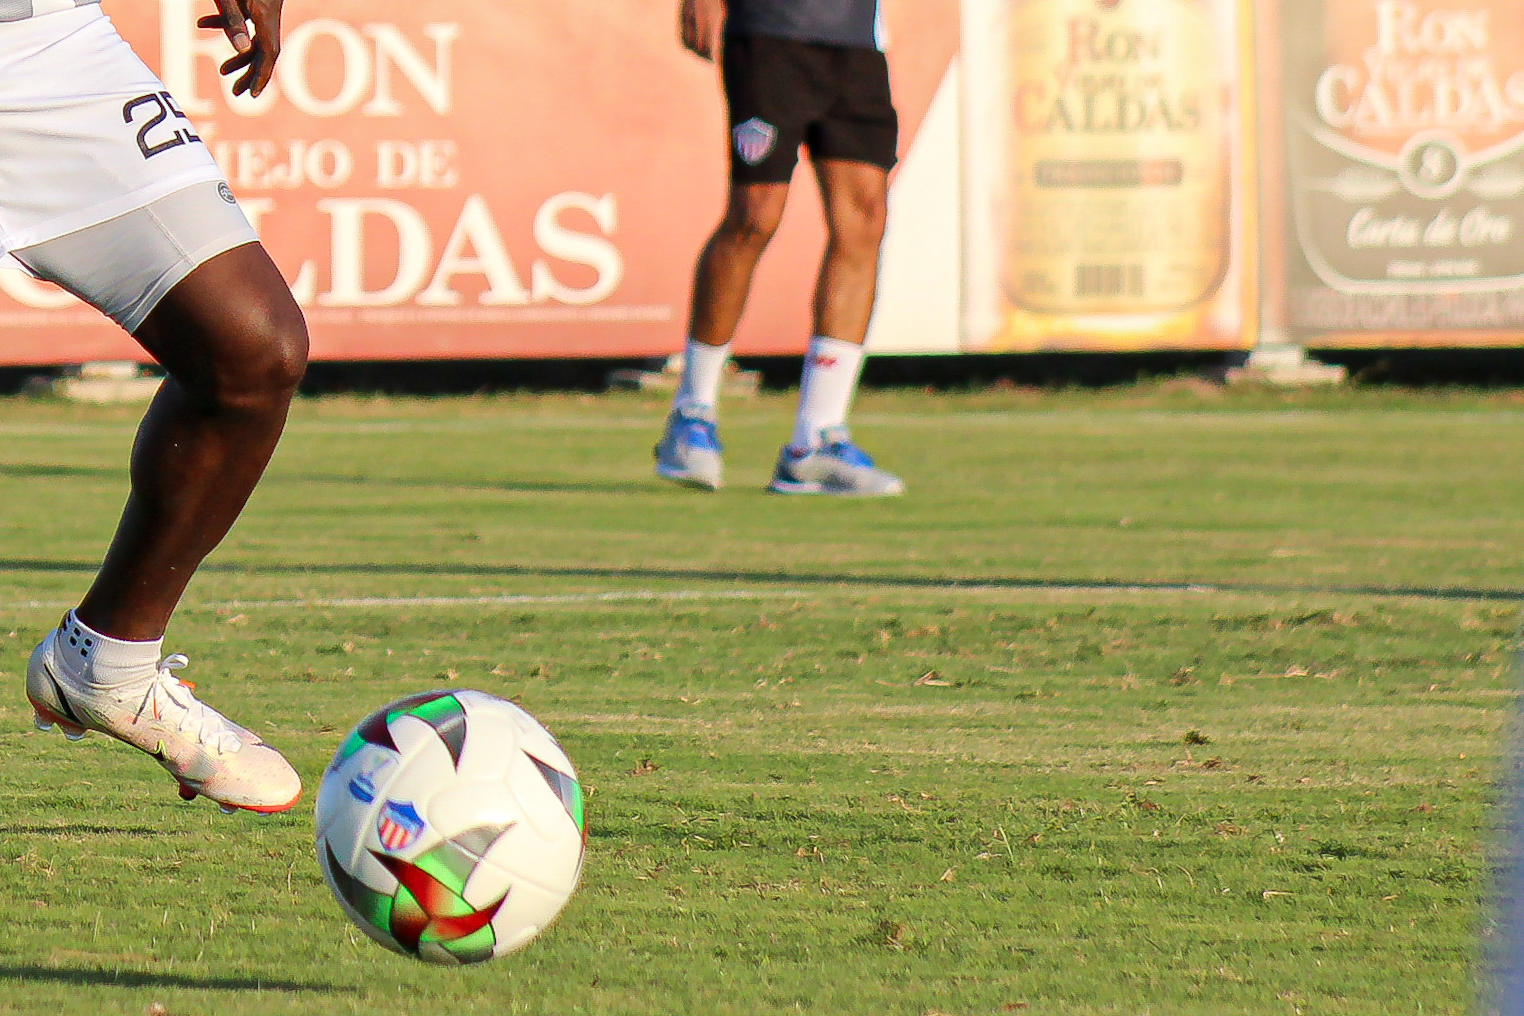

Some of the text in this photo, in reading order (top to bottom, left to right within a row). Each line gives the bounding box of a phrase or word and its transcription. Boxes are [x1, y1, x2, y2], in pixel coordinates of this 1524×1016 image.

[1009, 80, 1200, 136] CALDAS
[198, 122, 460, 189] IEJO DE
